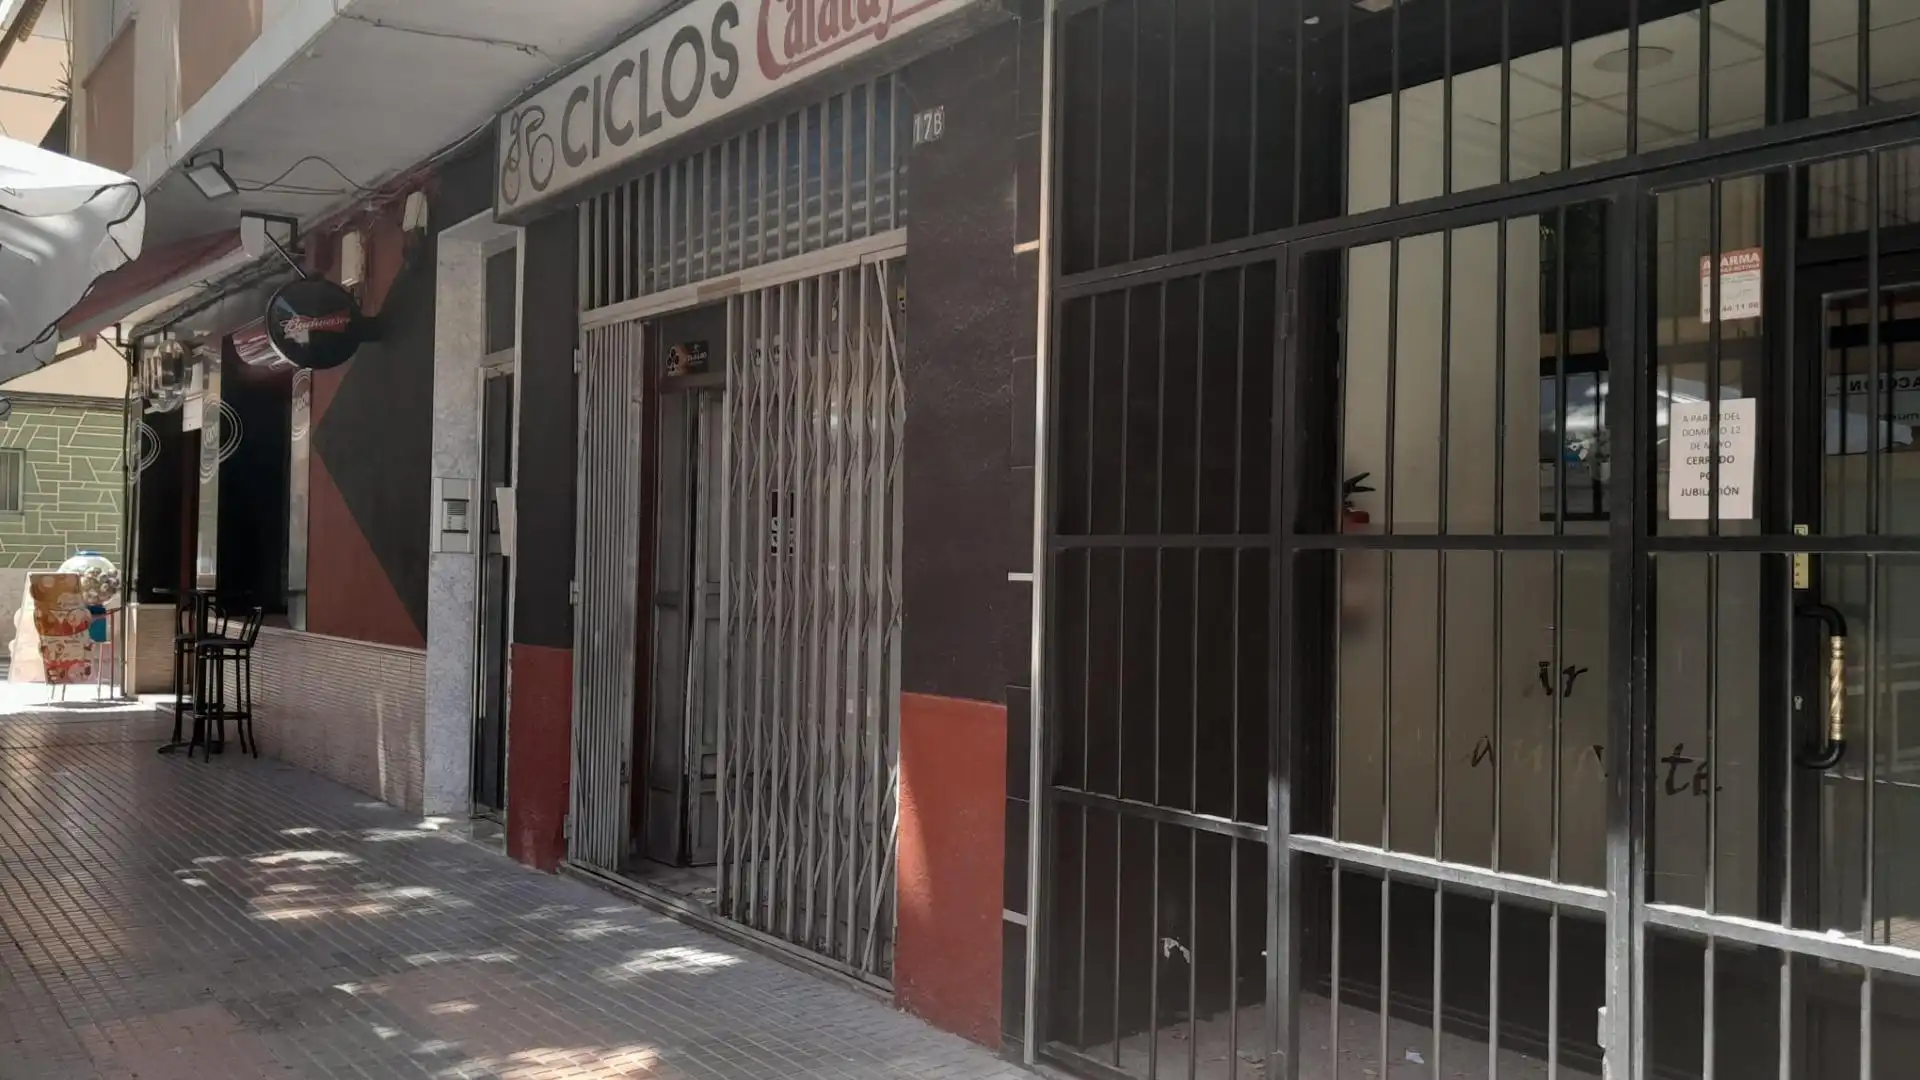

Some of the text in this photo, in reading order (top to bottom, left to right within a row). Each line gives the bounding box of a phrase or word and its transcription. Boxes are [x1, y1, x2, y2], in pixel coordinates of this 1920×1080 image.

[561, 1, 739, 167] CICLOS
[1703, 252, 1760, 269] AARMA
[1691, 413, 1723, 422] PAR
[1724, 412, 1741, 420] DEL
[1682, 426, 1741, 437] DOMIO 12
[1690, 440, 1732, 450] DE MYO
[1687, 455, 1735, 465] CERRDO
[1681, 485, 1739, 496] JUBILIÓN
